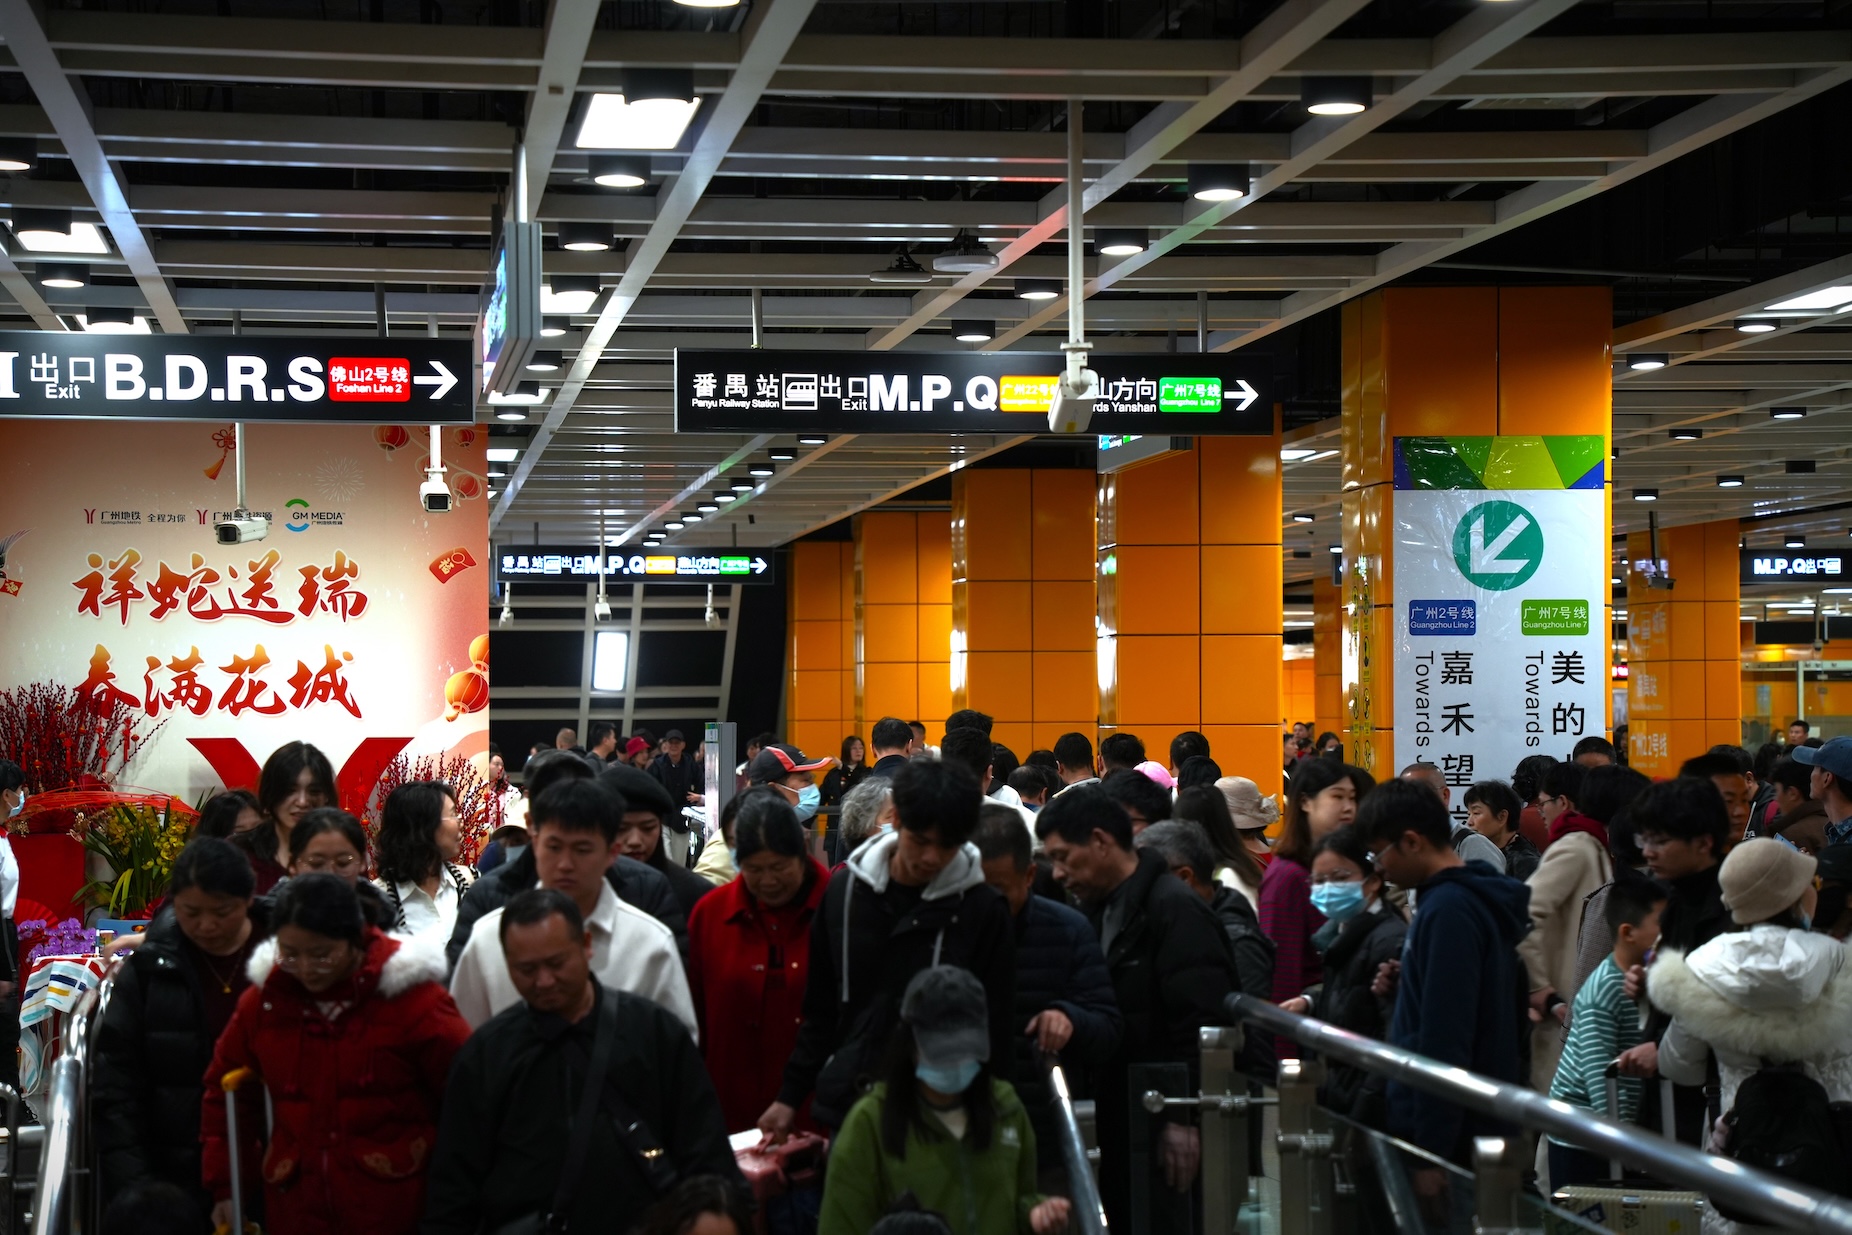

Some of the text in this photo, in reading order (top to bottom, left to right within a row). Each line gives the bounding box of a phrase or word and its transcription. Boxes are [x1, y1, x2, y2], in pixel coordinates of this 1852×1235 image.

[30, 352, 96, 384] 出口
[330, 366, 408, 383] 佛山2号线
[105, 354, 326, 401] B.D.R.S
[45, 383, 81, 399] Exit
[336, 383, 403, 393] Foshan Line 2
[692, 373, 780, 399] 番禺站
[819, 374, 868, 399] 出口
[869, 374, 999, 412] M.P.Q
[1097, 377, 1157, 401] 山方向
[1160, 384, 1221, 398] 广州7号线
[691, 399, 780, 409] Panyu Railway Station
[842, 399, 868, 410] Exit
[1111, 402, 1157, 412] Yanshan
[101, 511, 141, 520] 广州地铁
[147, 513, 186, 523] 全程为你
[292, 512, 343, 520] GM MEDIA
[1754, 558, 1807, 574] M.P.Q
[72, 548, 368, 626] 祥蛇送瑞
[1410, 606, 1475, 620] 广州2号线
[1523, 606, 1587, 620] 广州7号线
[1410, 621, 1475, 630] Guangzhou Line 2
[1523, 621, 1588, 630] Guangzhou Line 7
[72, 643, 363, 719] 春满花城
[1415, 650, 1434, 747] Towards
[1525, 650, 1544, 747] Towards
